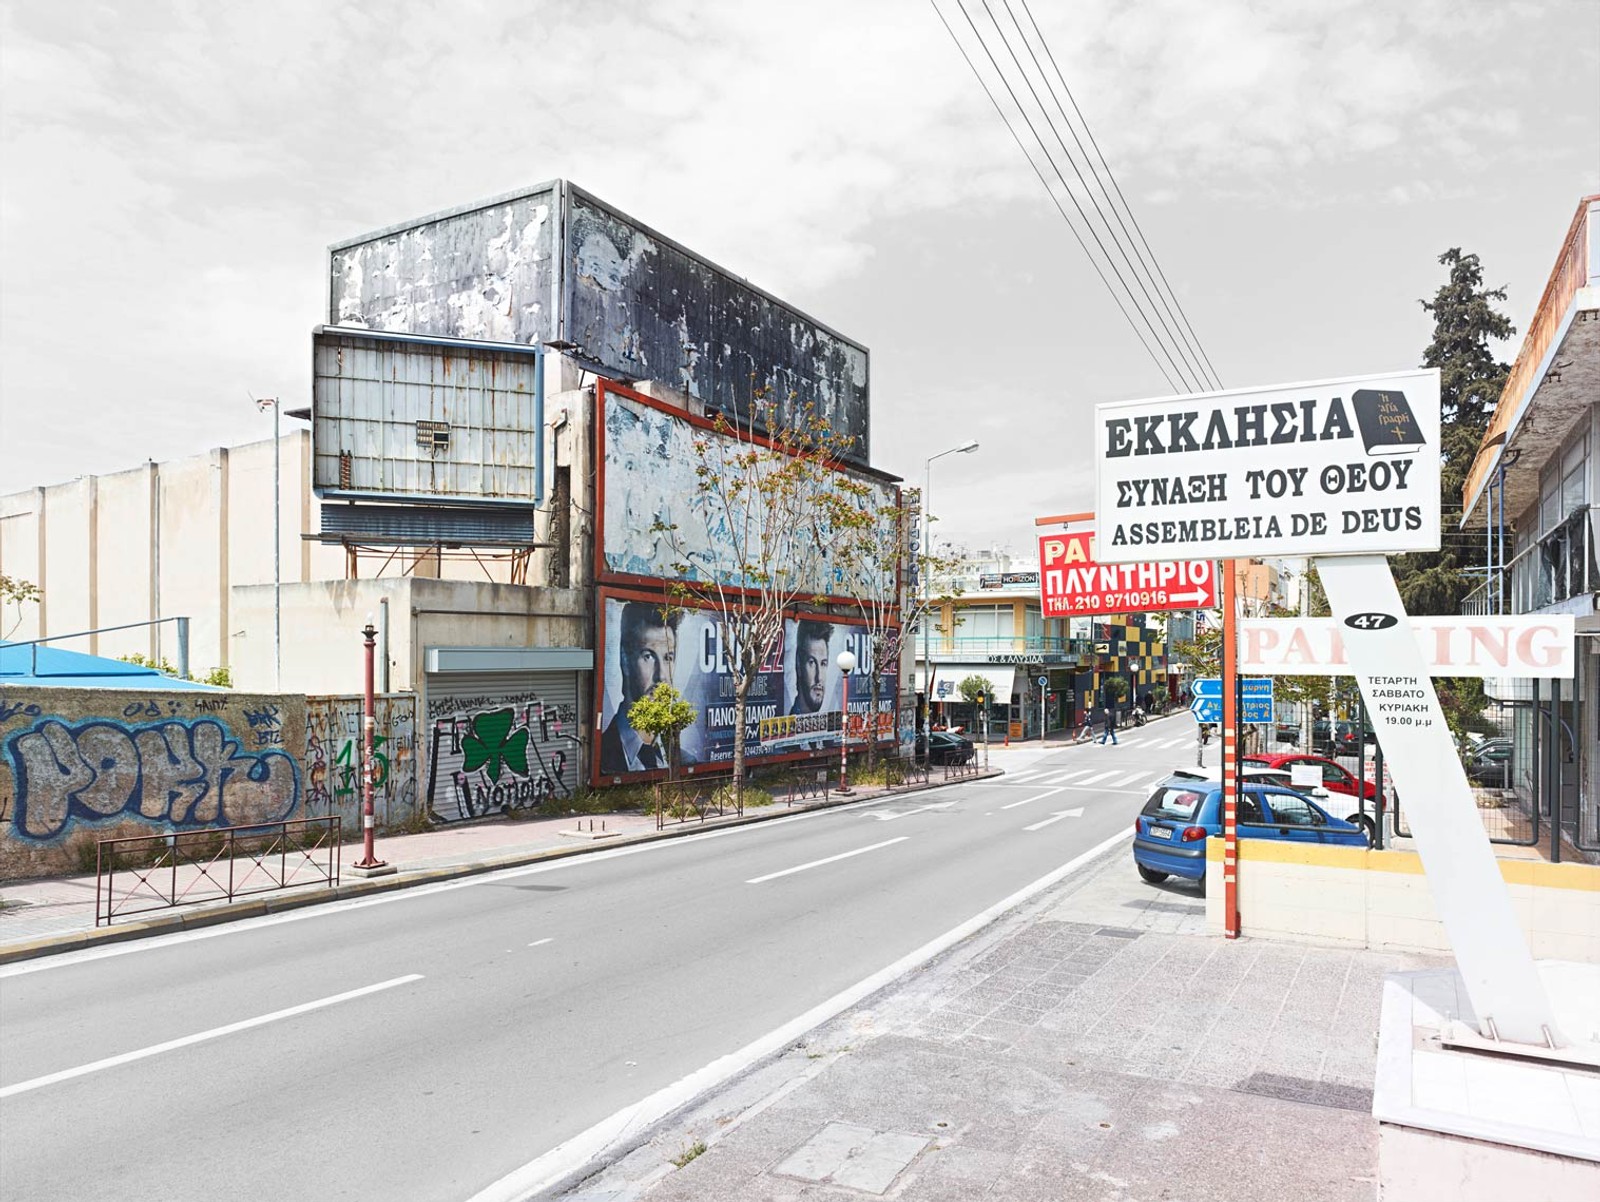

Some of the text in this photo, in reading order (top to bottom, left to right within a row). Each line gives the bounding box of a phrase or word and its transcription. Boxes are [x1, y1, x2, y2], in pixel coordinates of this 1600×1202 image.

[1105, 397, 1354, 458] ΕΚΚΛΗΣΙΑ
[1116, 459, 1413, 508] ΣΥΝΑΞΗ ΤΟΥ ΘΕΟΥ
[1111, 506, 1422, 546] ASSEMBLEIA DE DEUS
[1046, 560, 1210, 596] ΠΛΥΝΤΗΡΙΟ
[1075, 594, 1100, 610] 210
[1105, 591, 1167, 608] 9710916
[1354, 615, 1386, 629] 47
[1243, 625, 1568, 668] PAING
[1368, 676, 1417, 685] ΤΕΤΑΡΤΗ
[1372, 689, 1425, 698] ΣΑΒΒΑΤΟ
[1379, 704, 1429, 713] ΚΥΡΙΑΚΗ
[1385, 717, 1413, 725] 19.00
